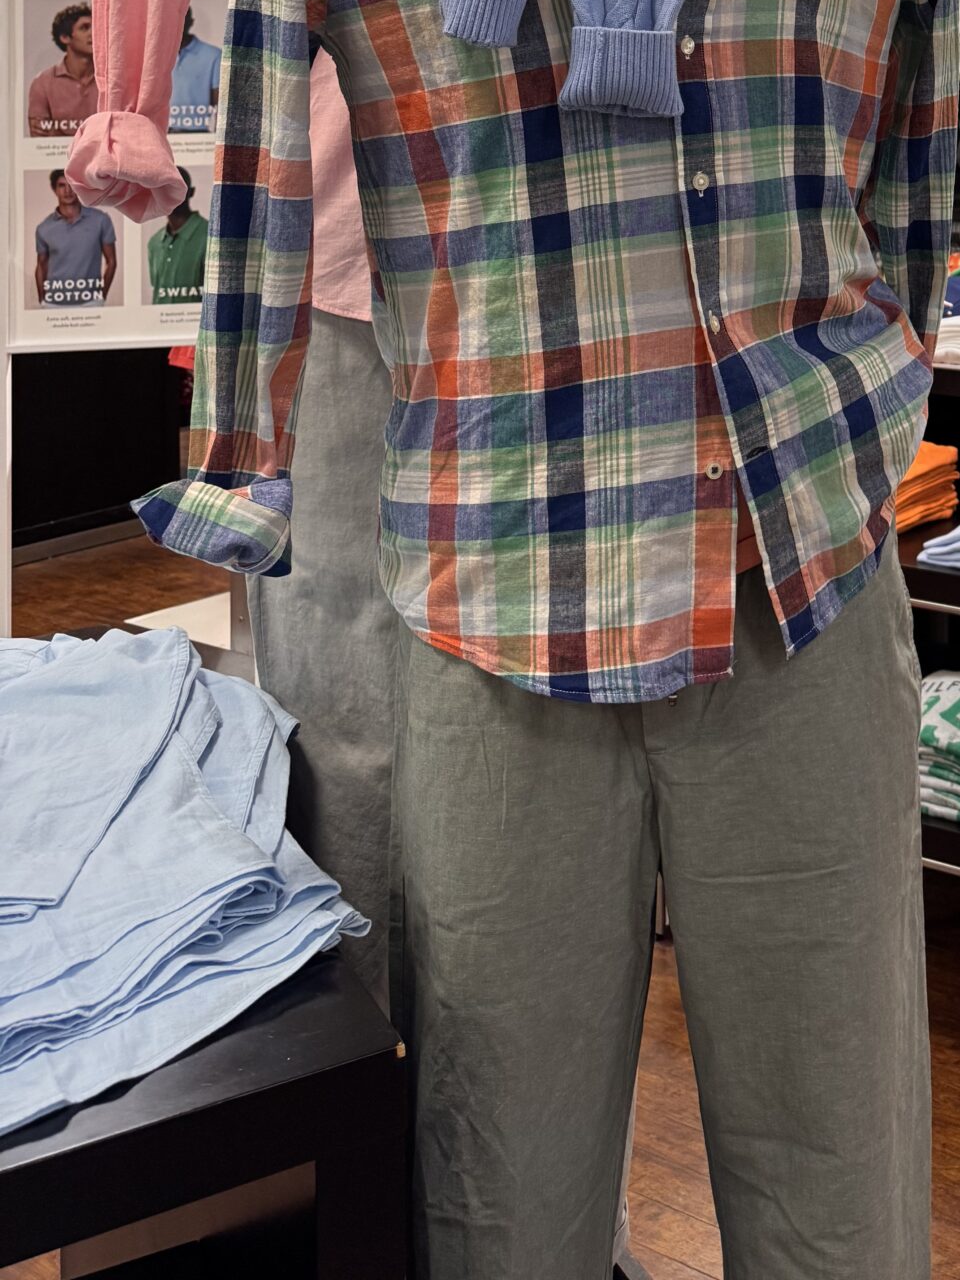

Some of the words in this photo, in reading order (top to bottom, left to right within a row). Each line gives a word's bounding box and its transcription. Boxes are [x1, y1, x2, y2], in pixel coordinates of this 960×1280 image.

[170, 105, 217, 115] OTTON
[40, 120, 81, 130] WICK
[43, 278, 105, 290] SMOOTH
[44, 290, 103, 302] COTTON
[158, 286, 204, 297] SWEAT
